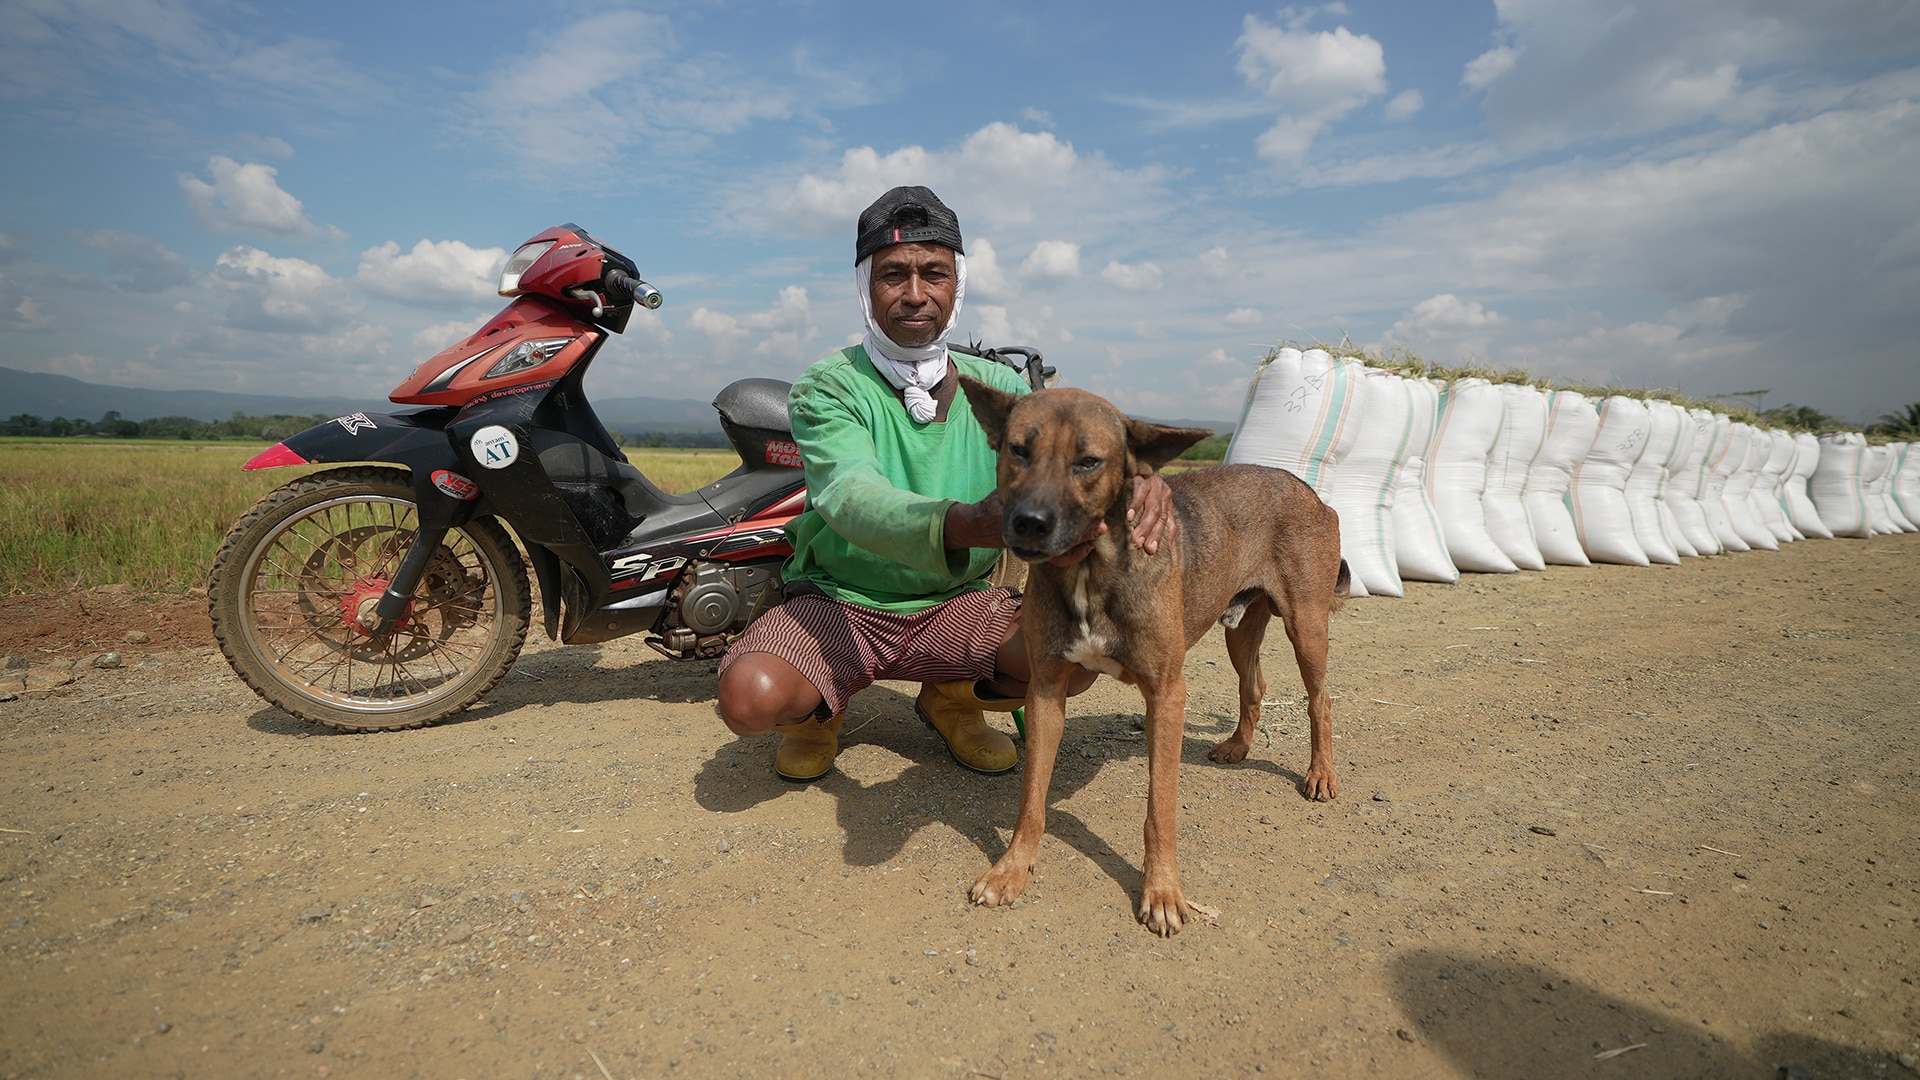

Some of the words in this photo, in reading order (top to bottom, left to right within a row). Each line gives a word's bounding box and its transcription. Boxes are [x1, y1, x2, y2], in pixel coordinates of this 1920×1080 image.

[491, 381, 551, 398] development
[486, 441, 511, 464] AT
[442, 474, 477, 494] YSS
